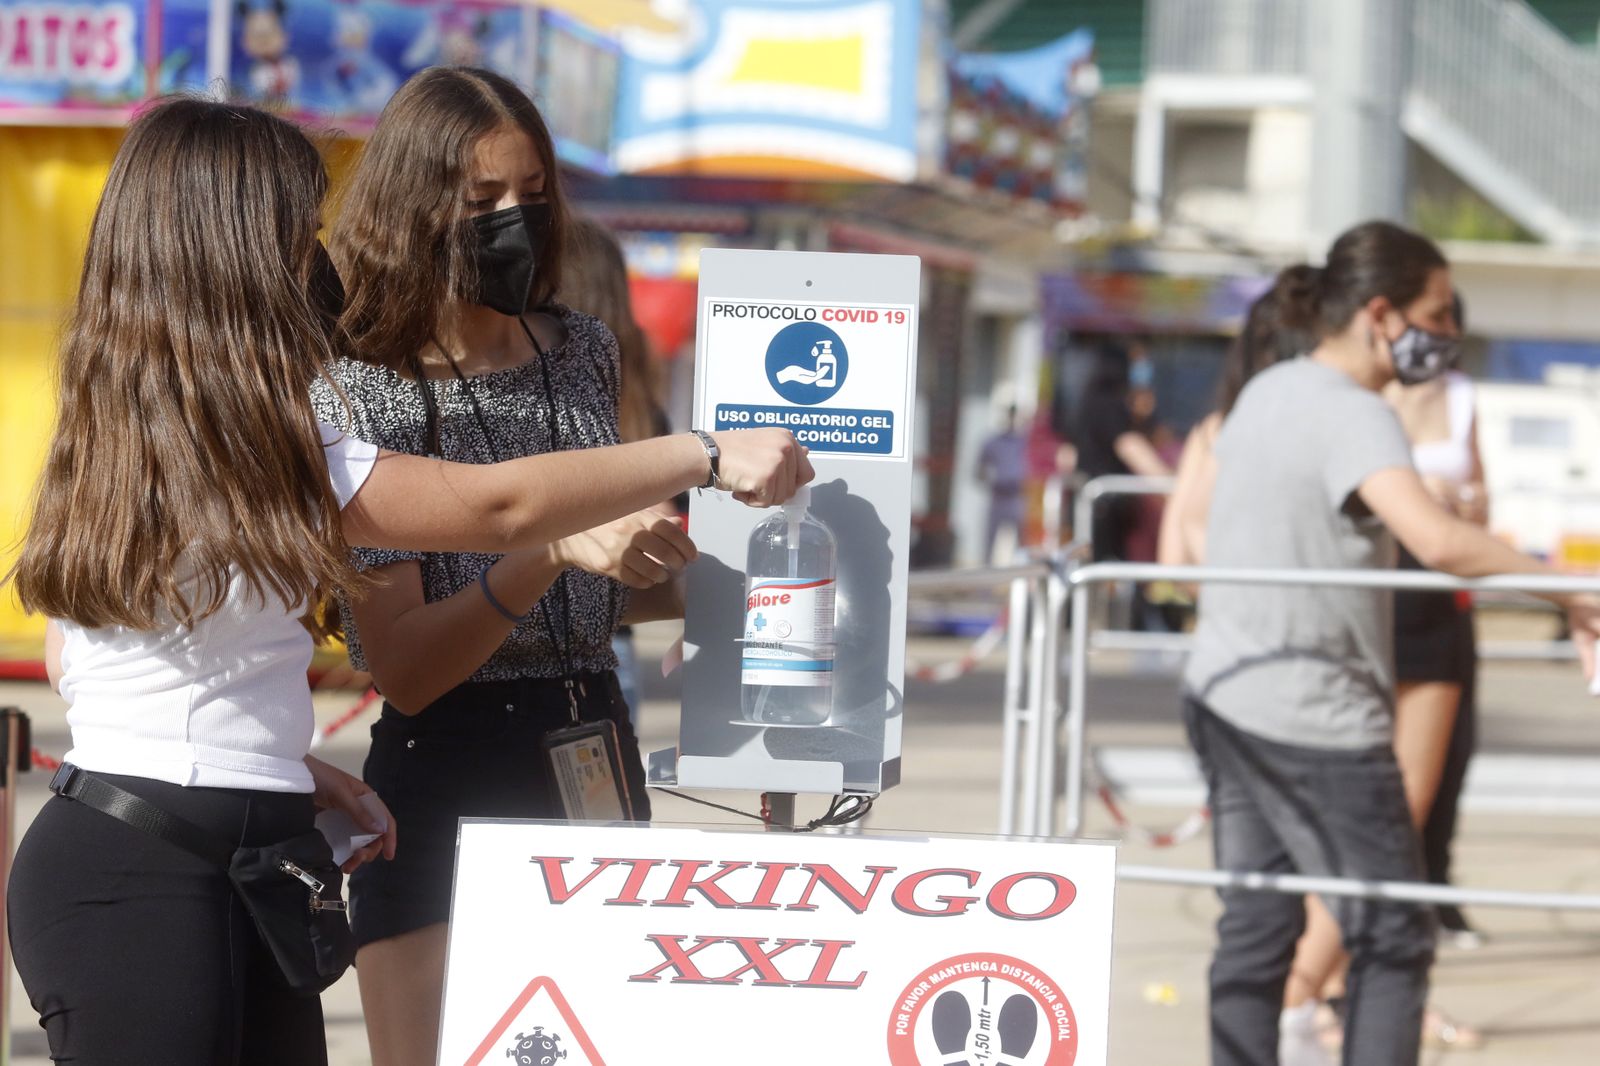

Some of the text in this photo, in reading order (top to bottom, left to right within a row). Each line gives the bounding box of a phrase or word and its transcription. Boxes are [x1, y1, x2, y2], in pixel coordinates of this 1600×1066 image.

[0, 16, 122, 69] ATOS
[713, 304, 905, 324] PROTOCOLO COVID 19
[718, 410, 891, 428] USO OBLIGATORIO GEL
[529, 856, 1077, 921] VIKINGO
[627, 934, 868, 989] XXL
[896, 961, 1071, 1041] POR FAVOR MANTENGA DISTANCIA SOCIAL
[974, 1008, 992, 1060] 1,50 mtr
